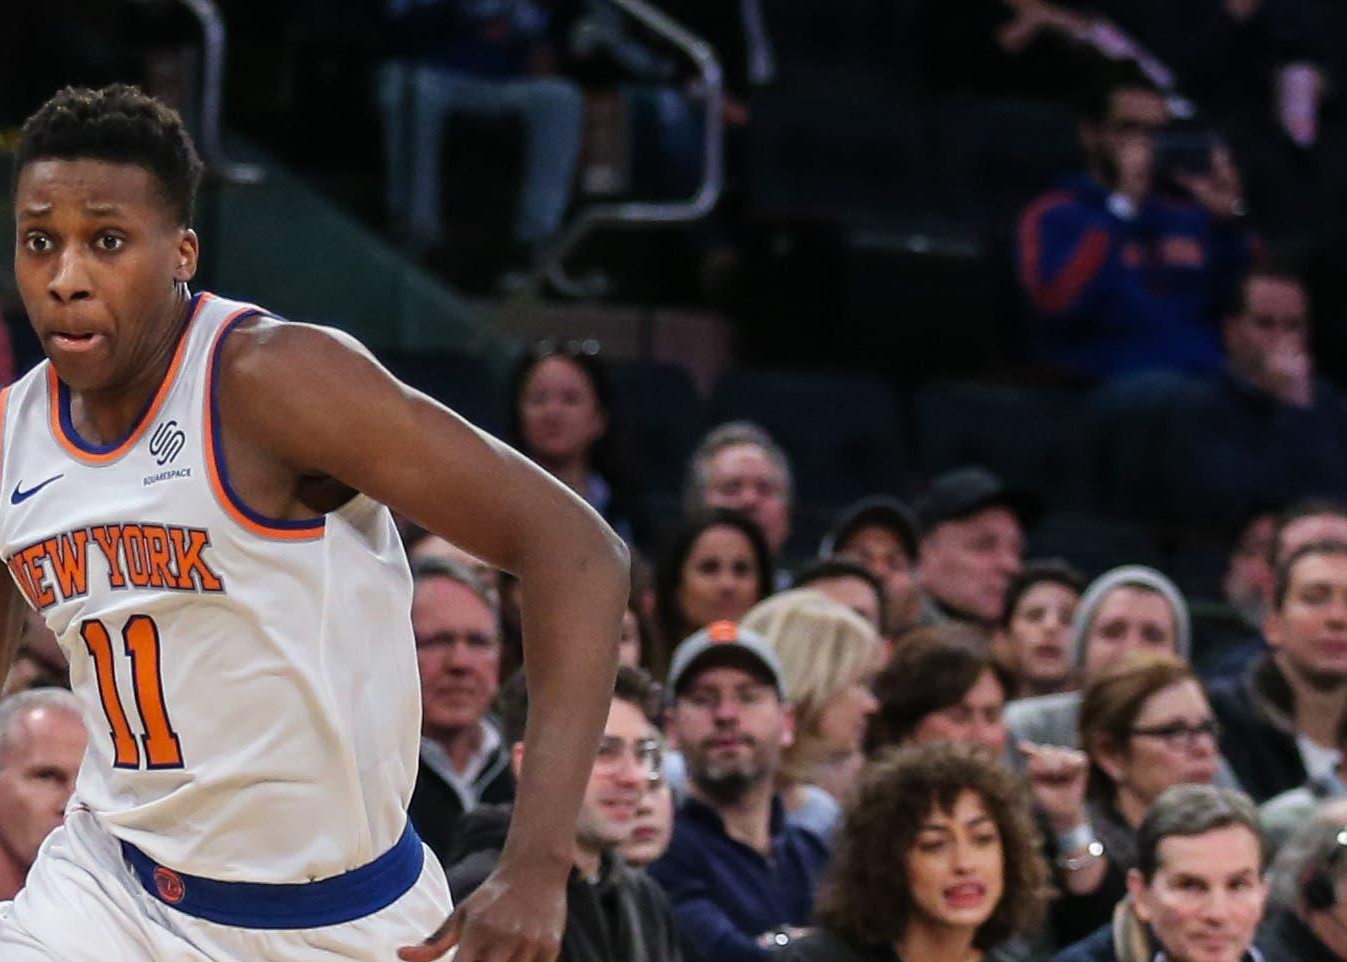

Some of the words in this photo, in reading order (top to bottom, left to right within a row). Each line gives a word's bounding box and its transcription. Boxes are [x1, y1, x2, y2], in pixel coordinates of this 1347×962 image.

[143, 467, 192, 486] SQUARESPACE
[7, 528, 89, 610] NEW
[90, 521, 228, 594] YORK
[78, 614, 185, 771] 11
